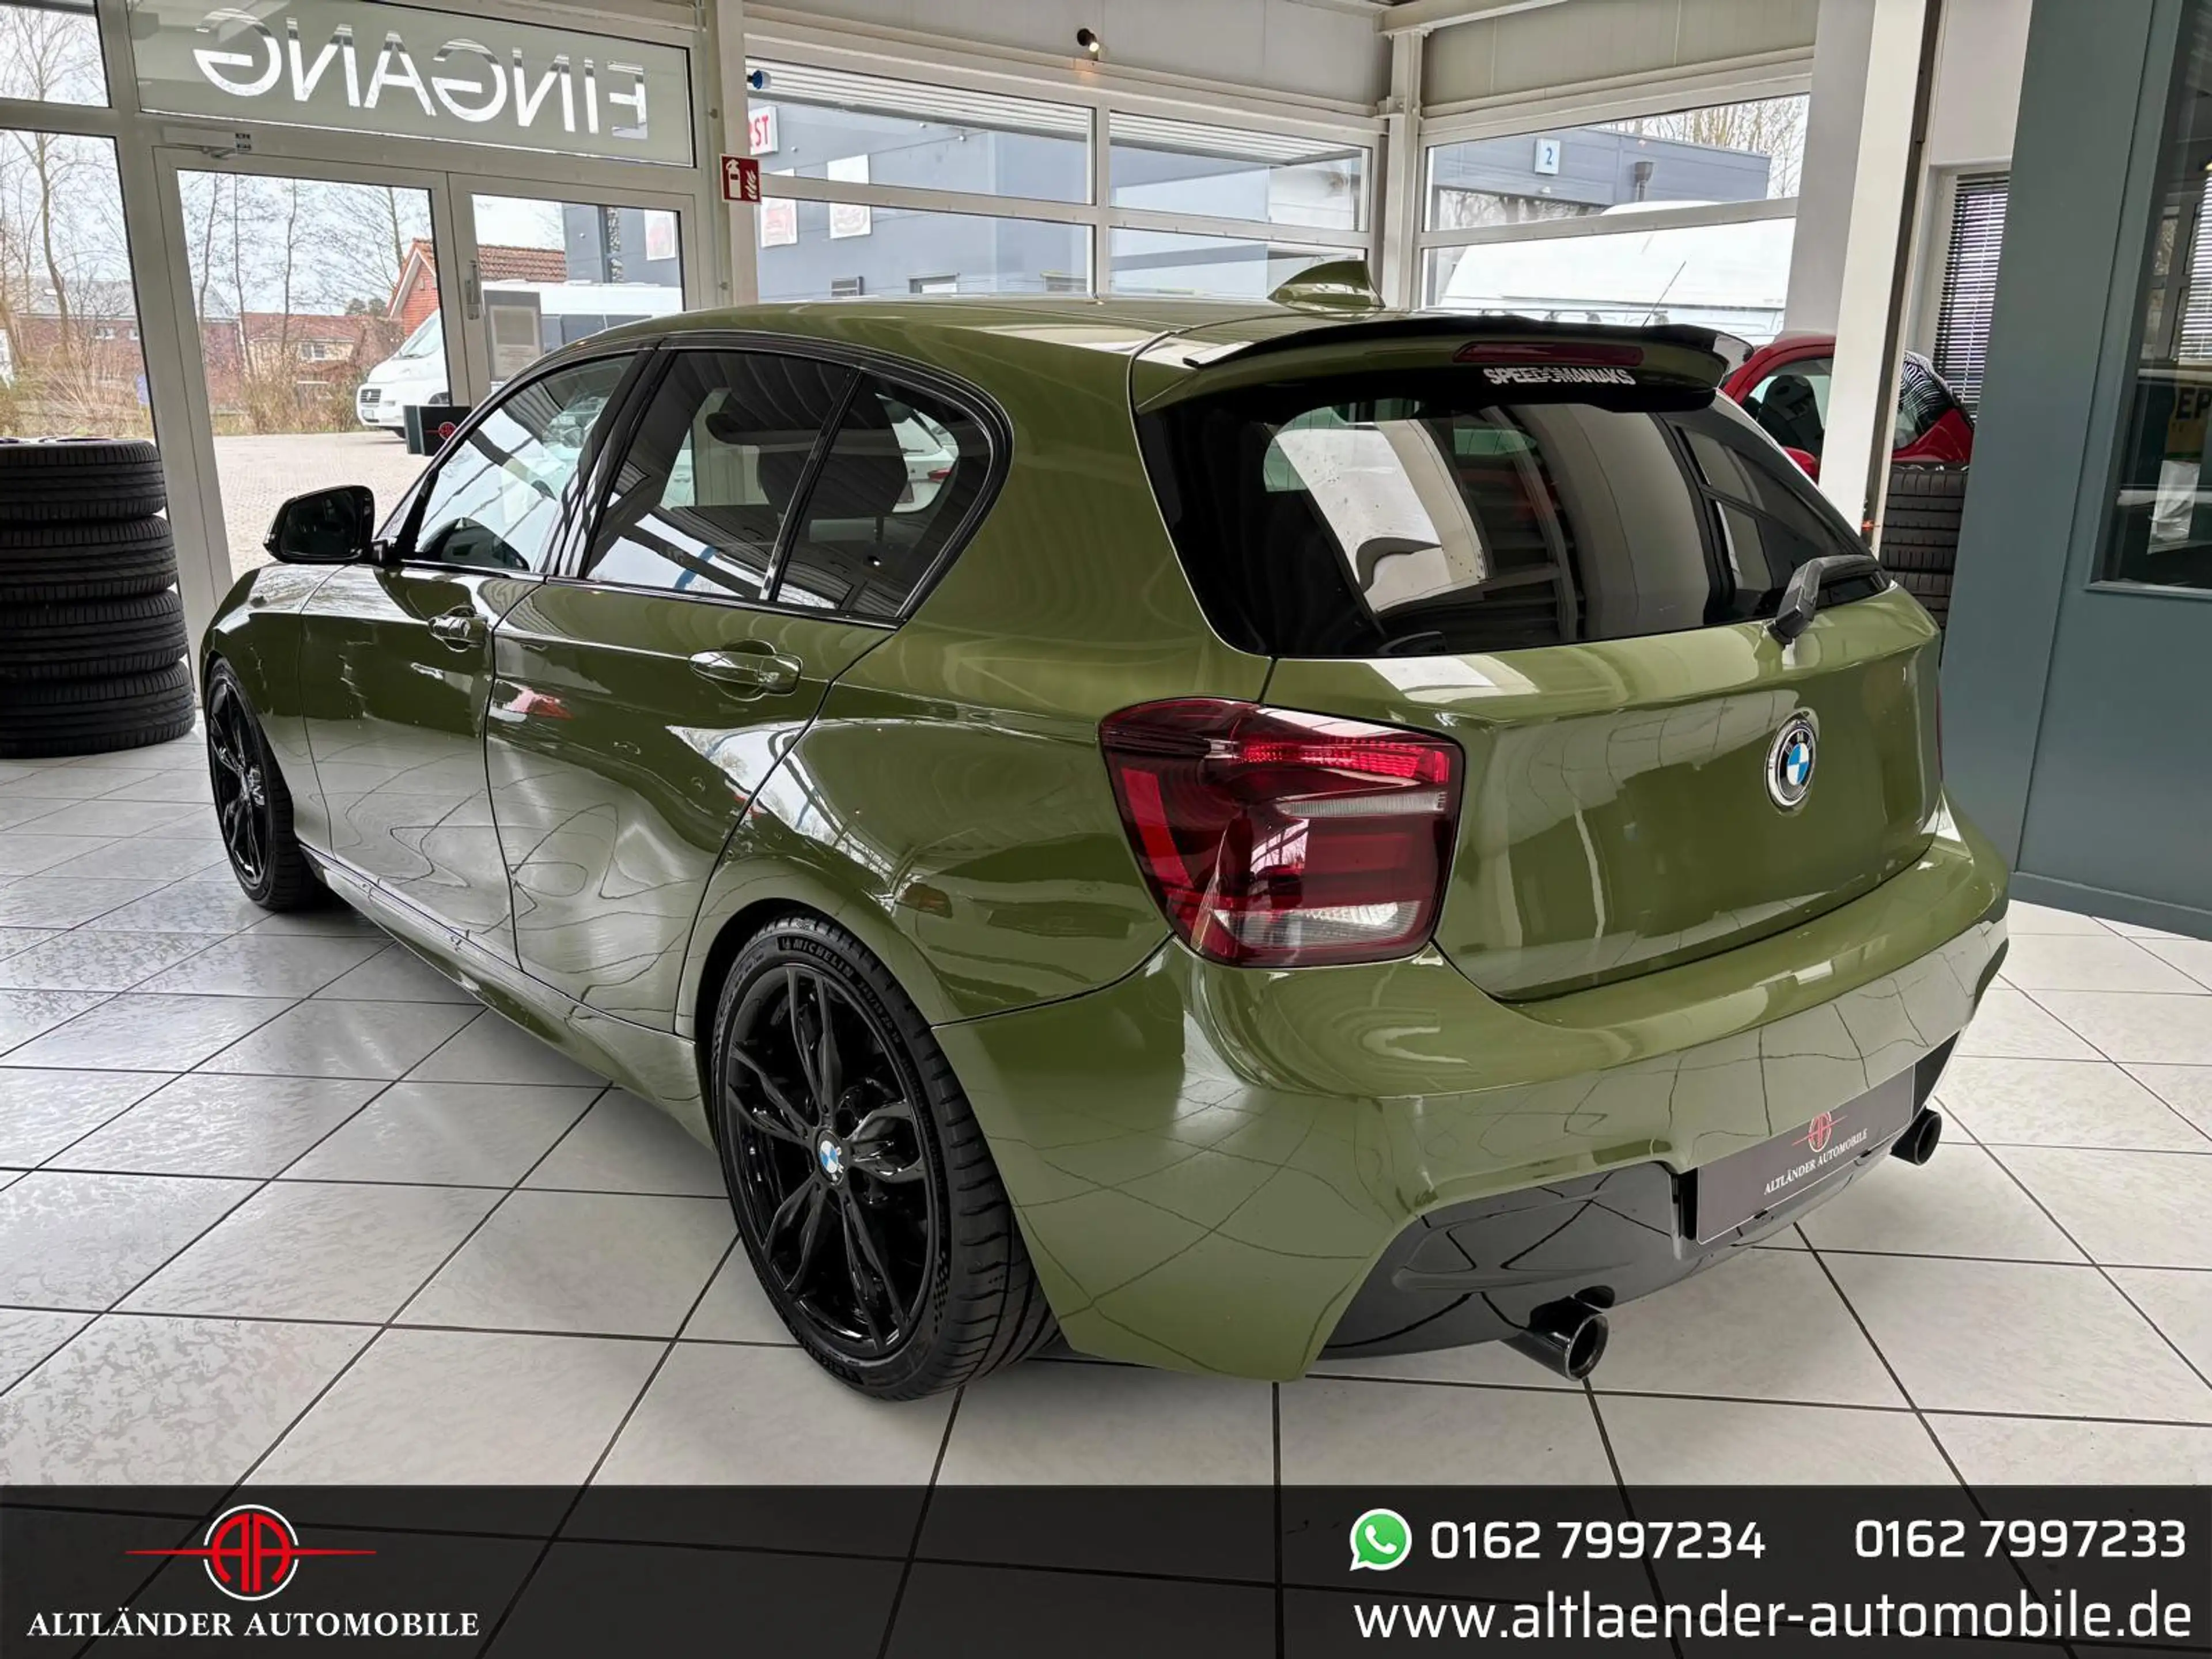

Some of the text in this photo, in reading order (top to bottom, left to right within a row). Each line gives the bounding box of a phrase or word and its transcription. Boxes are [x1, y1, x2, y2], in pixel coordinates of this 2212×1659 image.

[1546, 146, 1553, 166] 2
[792, 938, 856, 979] MICHELIN
[1764, 1128, 1868, 1195] ALTLÄNDER AUTOMOBILE
